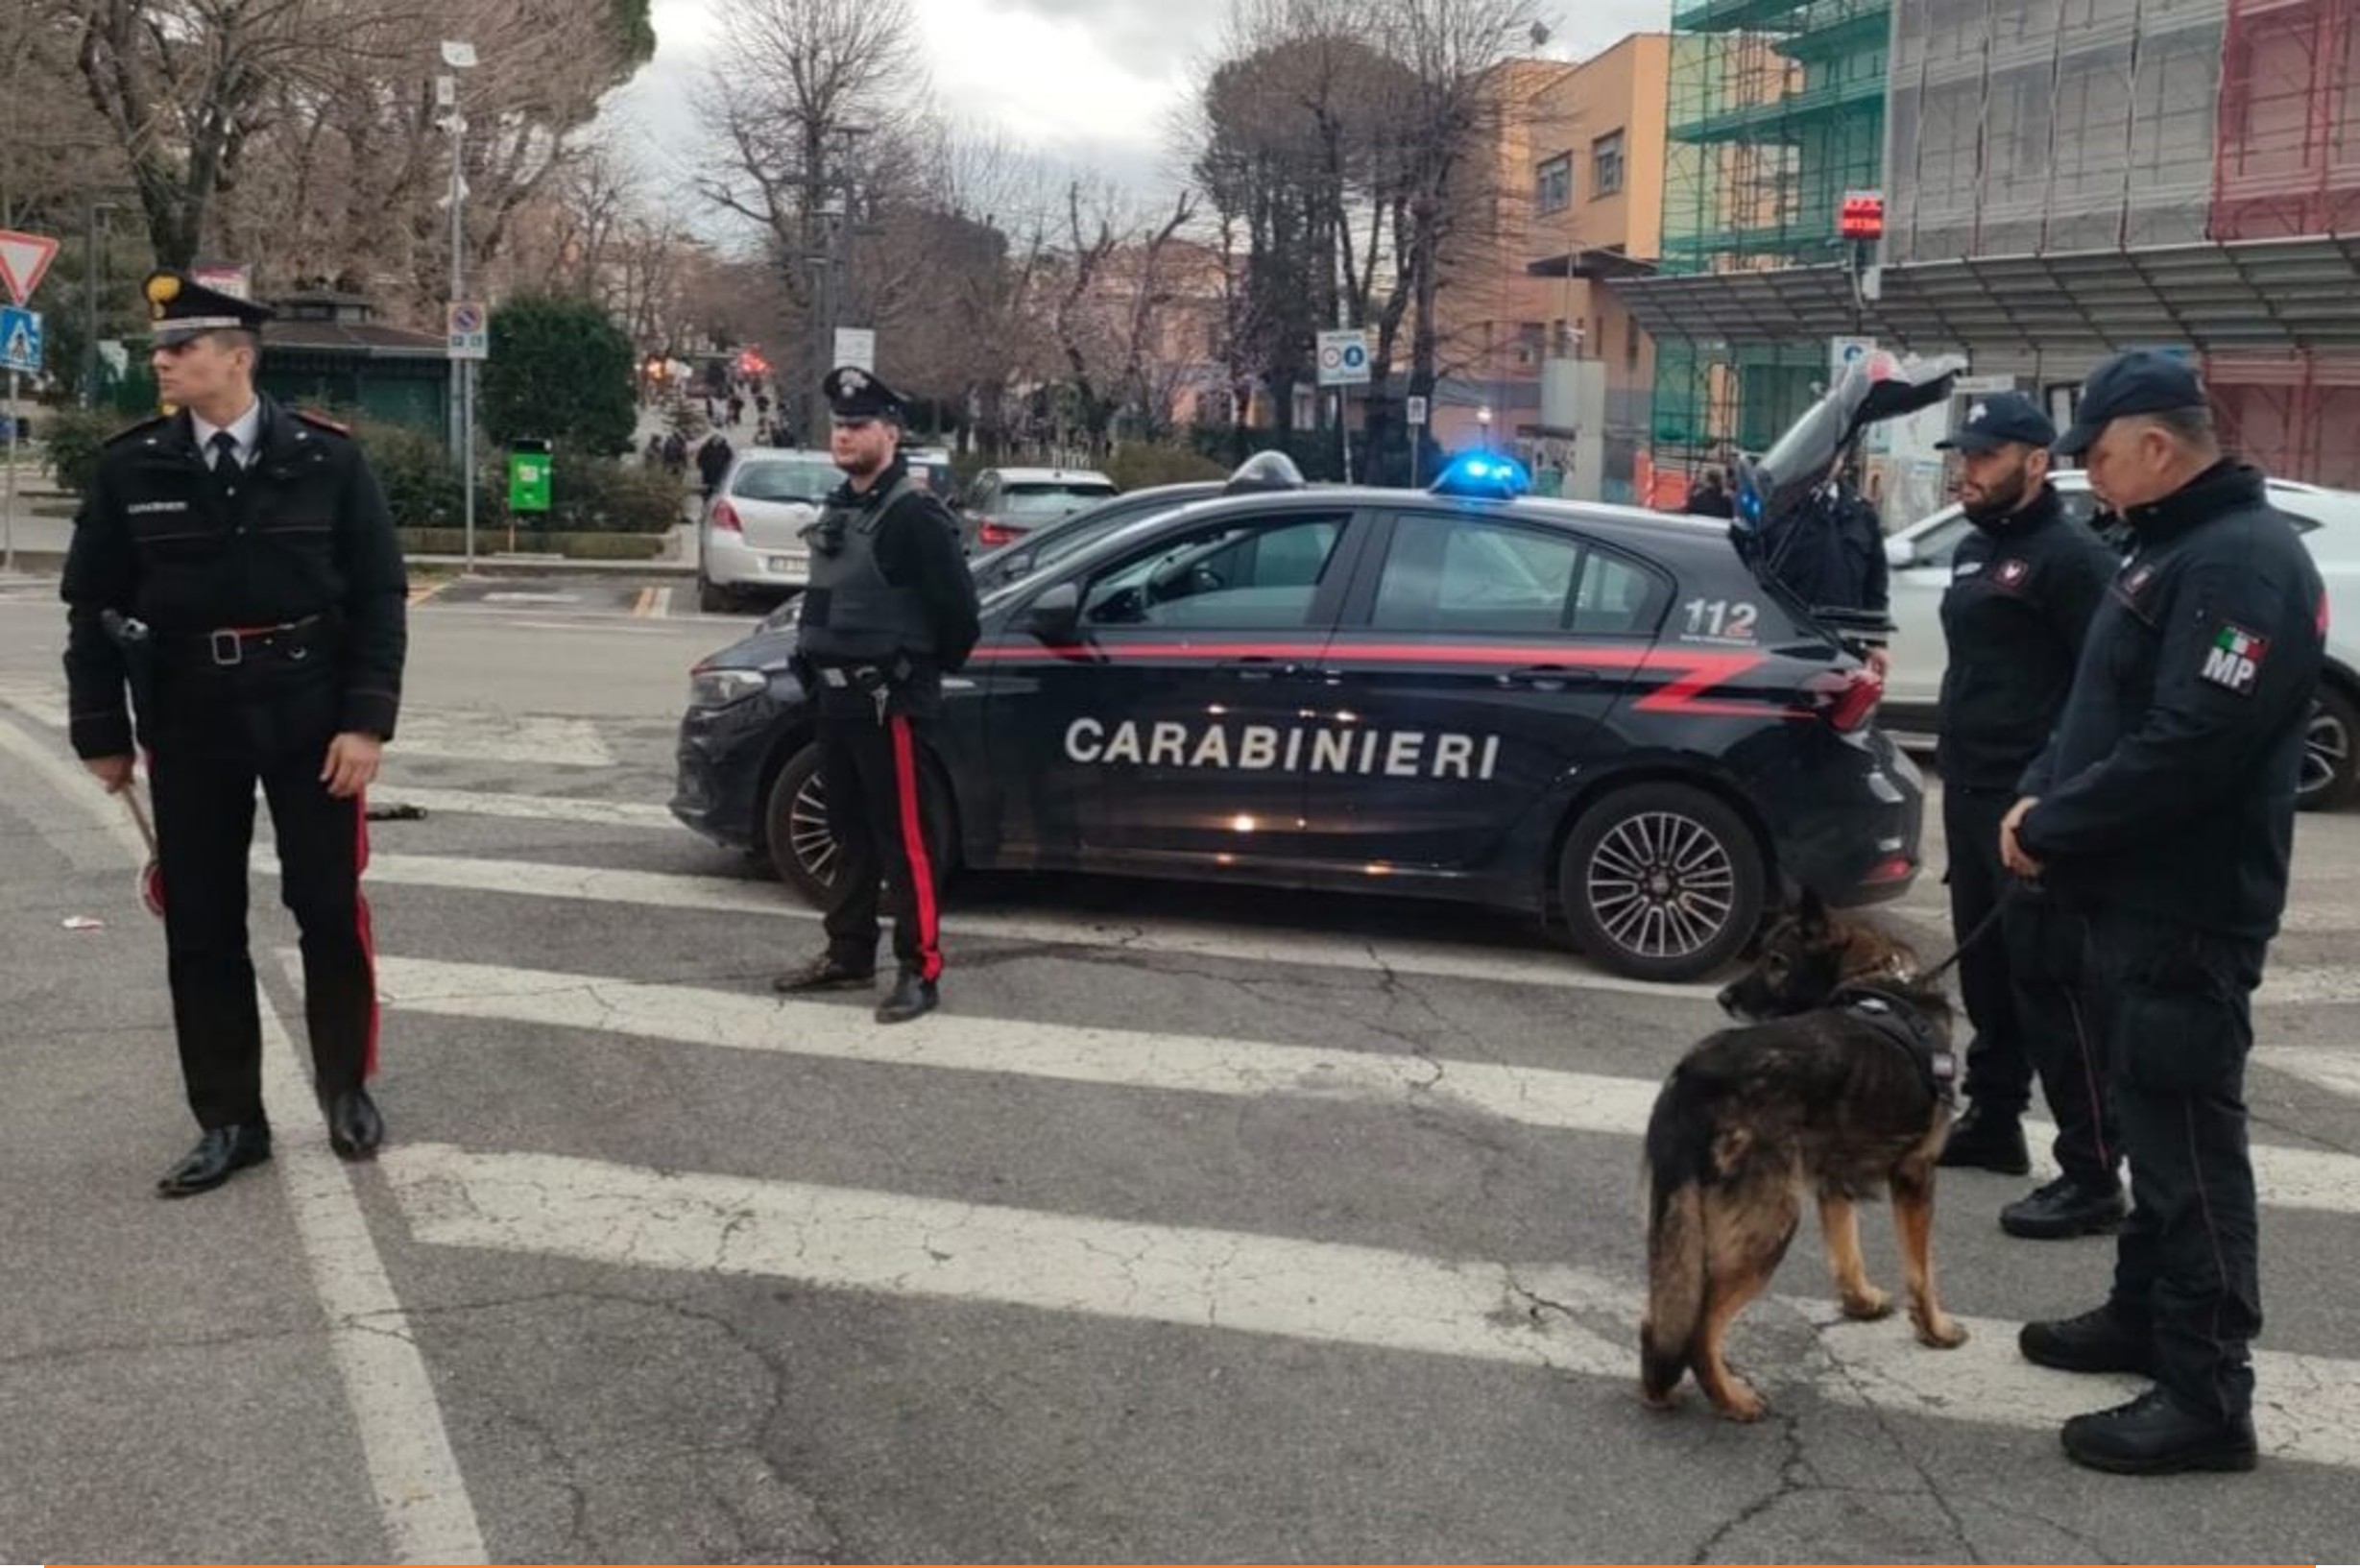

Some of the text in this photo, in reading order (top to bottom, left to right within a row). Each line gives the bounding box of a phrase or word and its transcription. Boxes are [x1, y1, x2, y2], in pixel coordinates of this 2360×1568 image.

[1684, 598, 1758, 637] 112
[2202, 646, 2255, 688] MP
[1065, 718, 1500, 780] CARABINIERI
